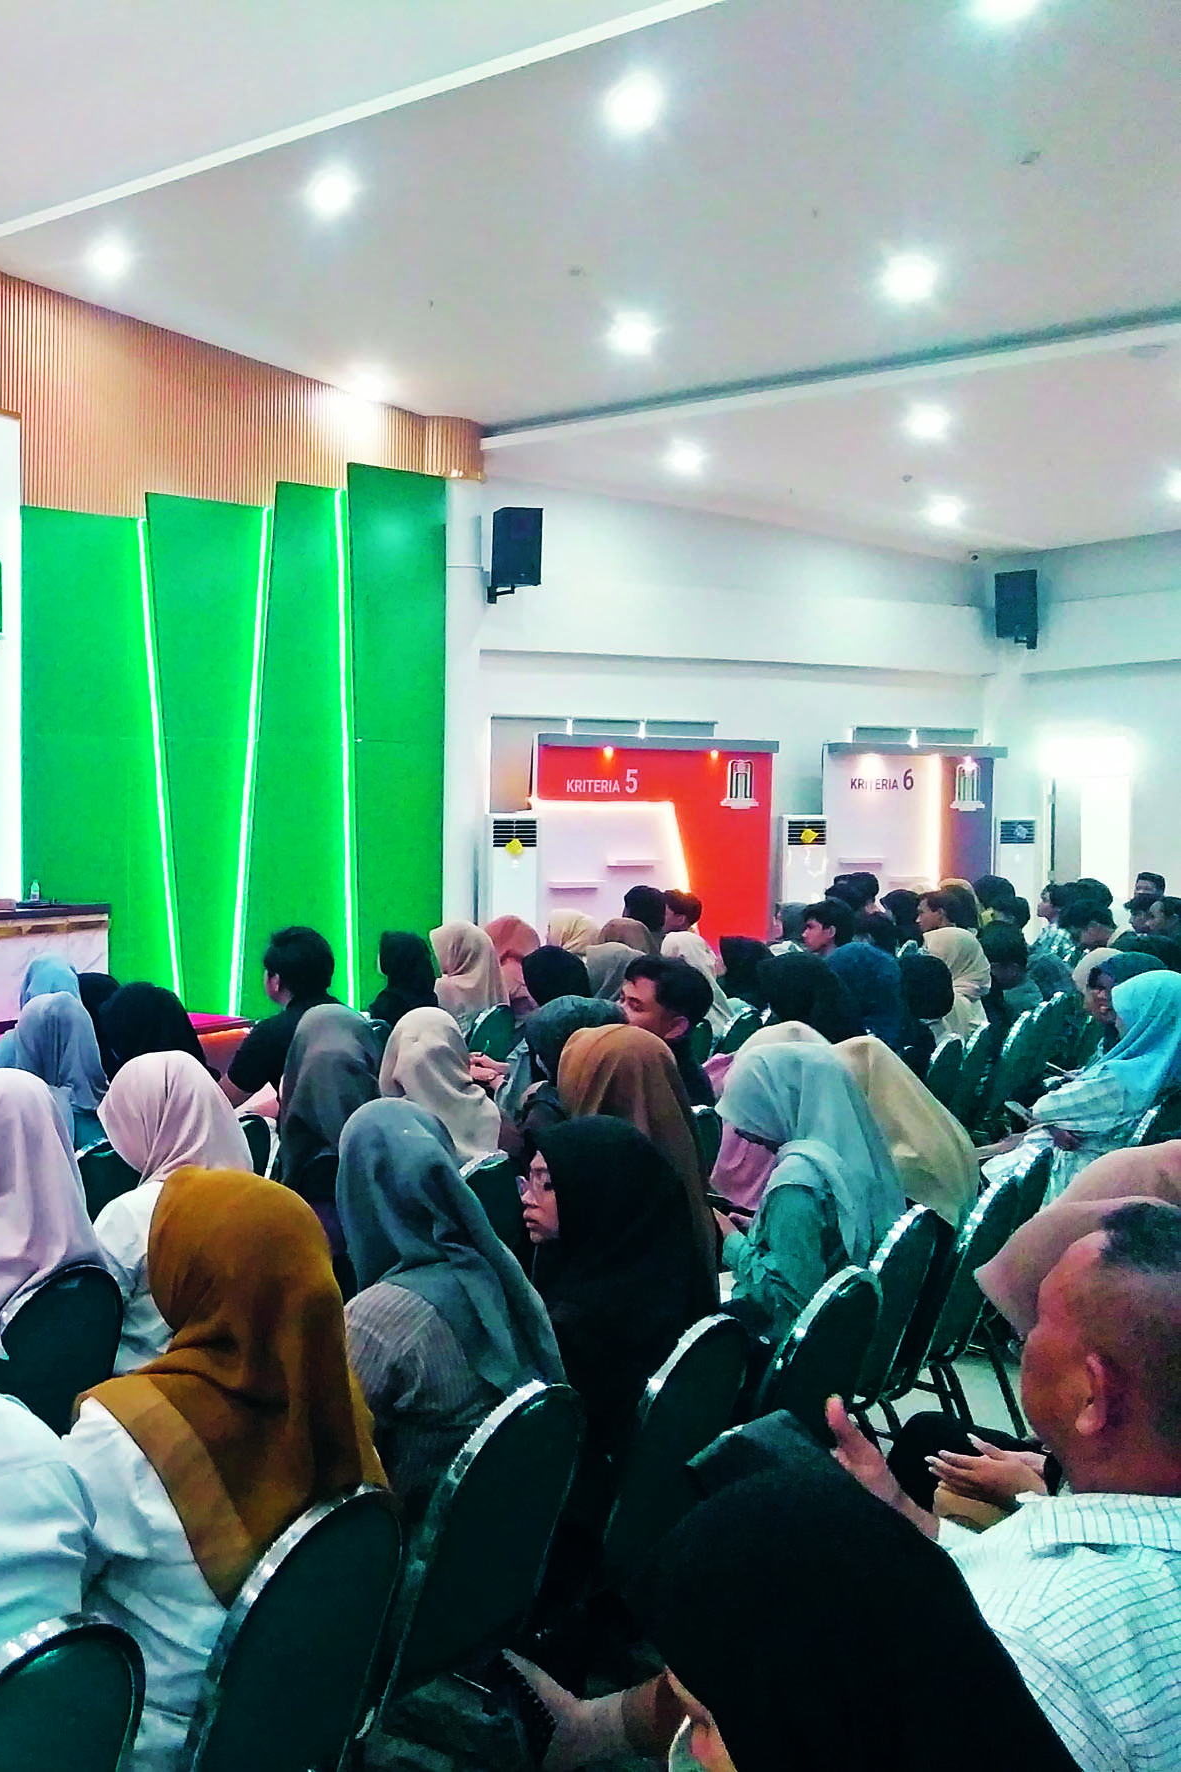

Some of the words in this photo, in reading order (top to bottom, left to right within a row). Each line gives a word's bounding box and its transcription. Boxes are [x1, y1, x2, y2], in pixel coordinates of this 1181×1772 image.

[566, 778, 620, 793] KRITERIA
[625, 768, 638, 793] 5
[903, 768, 914, 791] 6
